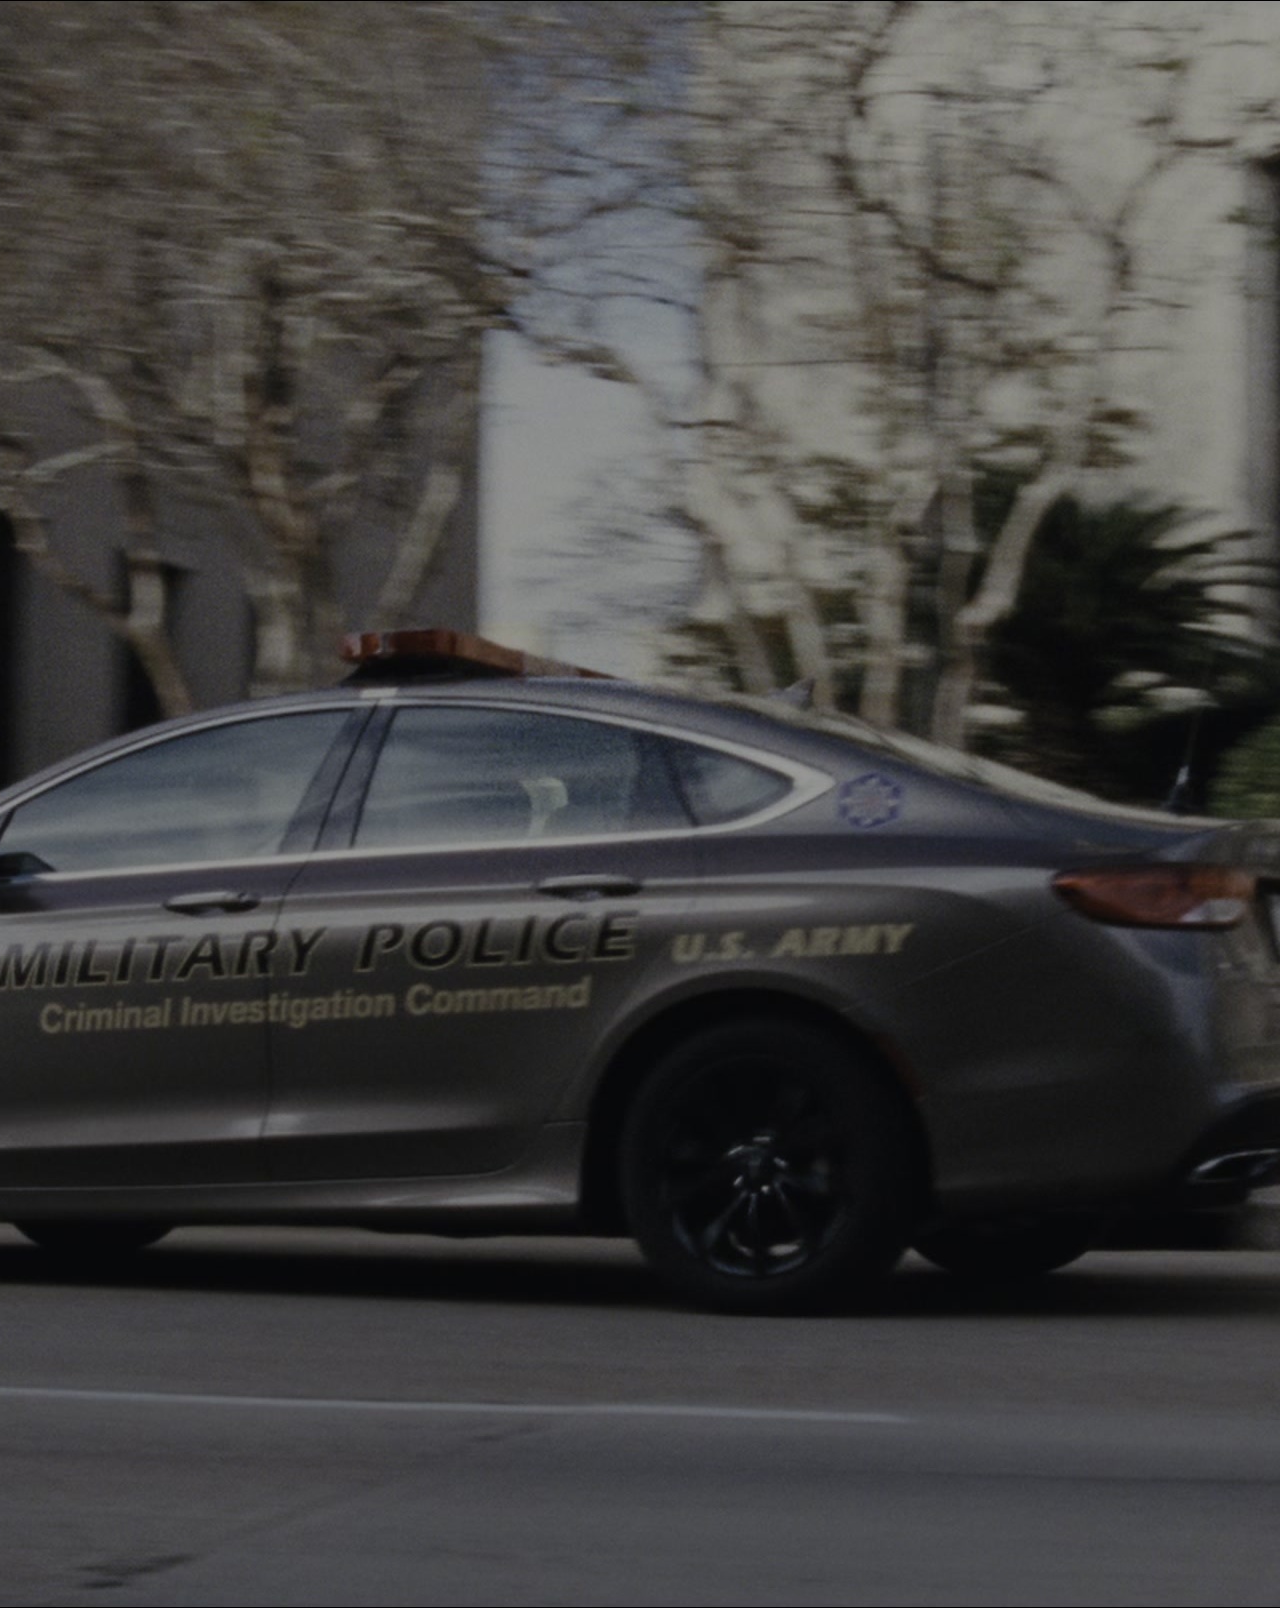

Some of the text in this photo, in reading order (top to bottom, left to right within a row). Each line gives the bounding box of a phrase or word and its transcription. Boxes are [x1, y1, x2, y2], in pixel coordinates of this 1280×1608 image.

[356, 911, 640, 973] POLICE
[672, 923, 916, 963] U.S. ARMY
[40, 978, 589, 1034] Criminal Investigation Command
